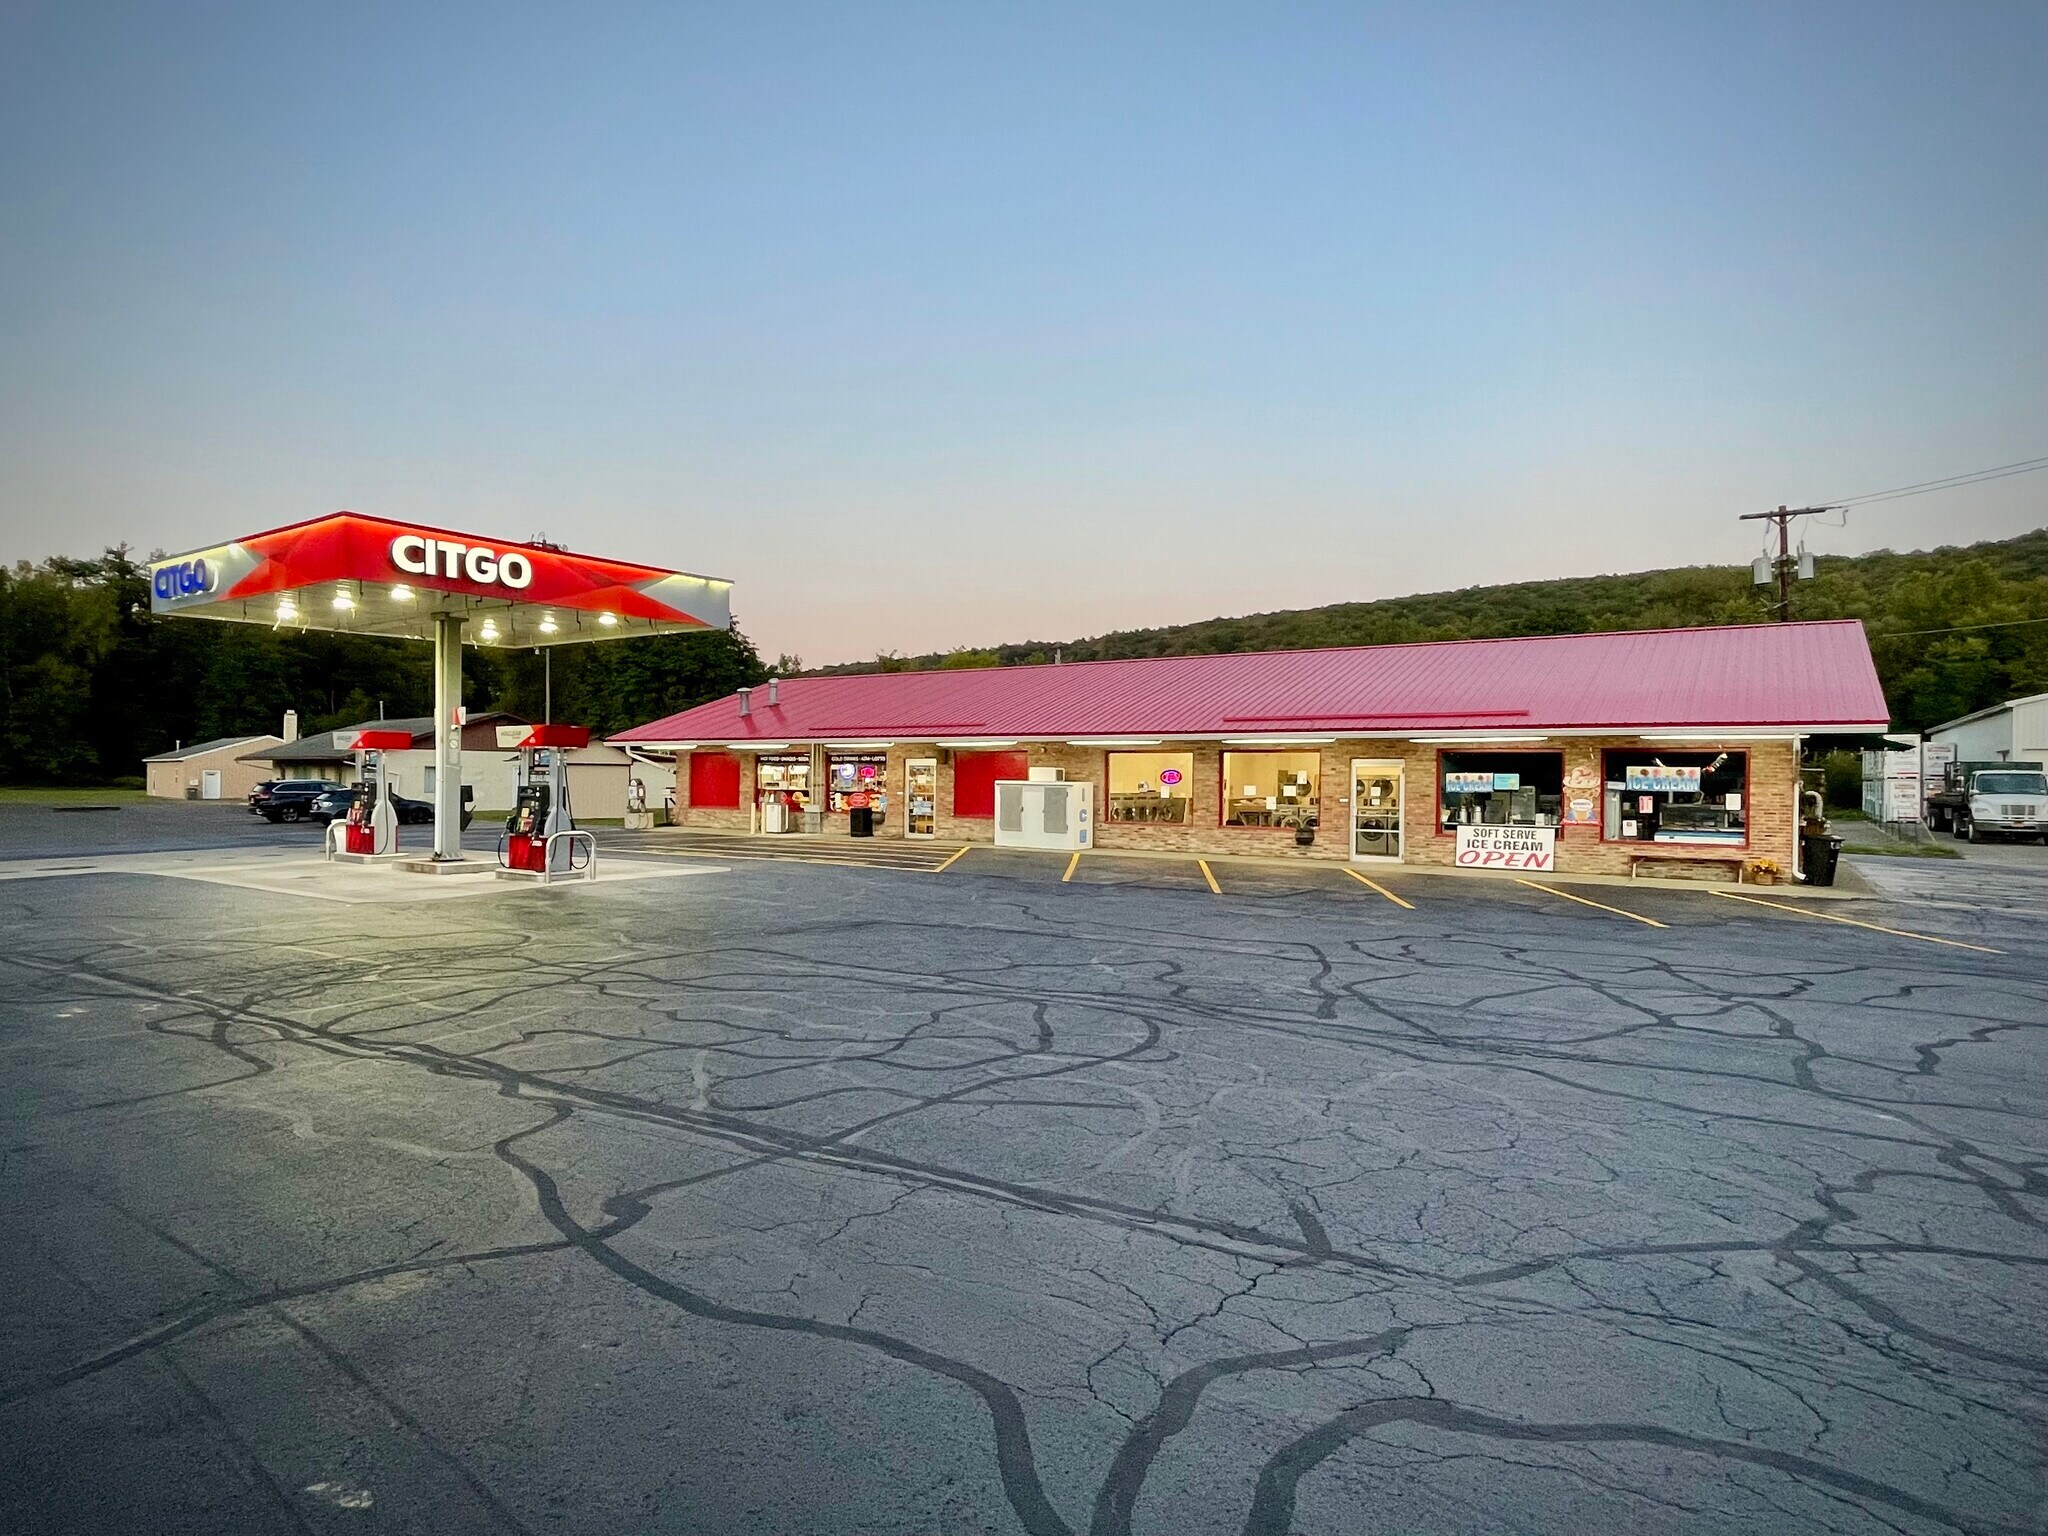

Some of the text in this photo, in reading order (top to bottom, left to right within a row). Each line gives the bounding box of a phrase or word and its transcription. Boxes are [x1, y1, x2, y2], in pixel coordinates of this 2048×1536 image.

[391, 535, 532, 589] CITGO
[154, 558, 207, 599] CITGO
[1628, 778, 1700, 790] ICE CREAM
[1473, 828, 1537, 840] SOFT SERVE
[1467, 839, 1543, 851] ICE CREAM
[1458, 850, 1550, 868] OPEN
